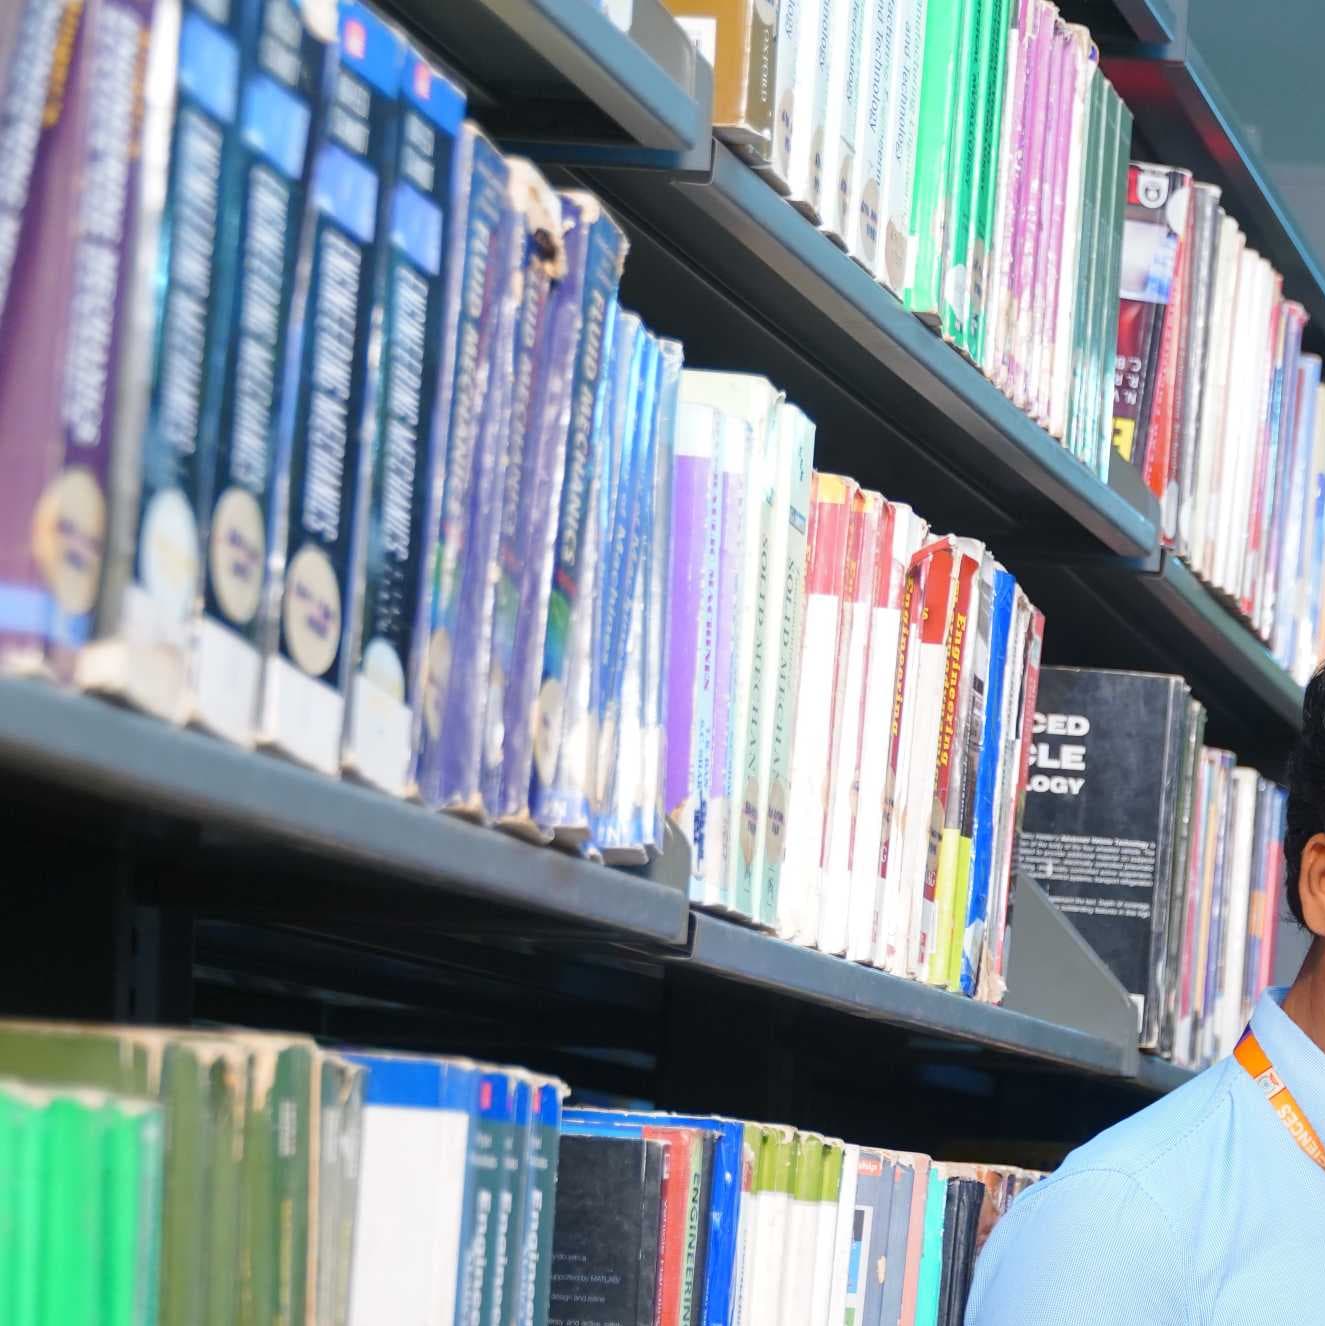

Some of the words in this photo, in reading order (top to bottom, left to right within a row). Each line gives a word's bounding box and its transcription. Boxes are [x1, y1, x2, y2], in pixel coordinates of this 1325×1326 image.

[896, 63, 911, 163] Technology
[465, 218, 489, 319] FLUID
[586, 289, 604, 380] FLUID
[381, 416, 418, 563] MECHANICS
[446, 331, 480, 523] MECHANICS
[561, 391, 594, 568] MECHANICS
[891, 574, 915, 738] Engineering
[938, 613, 967, 767] Engineering
